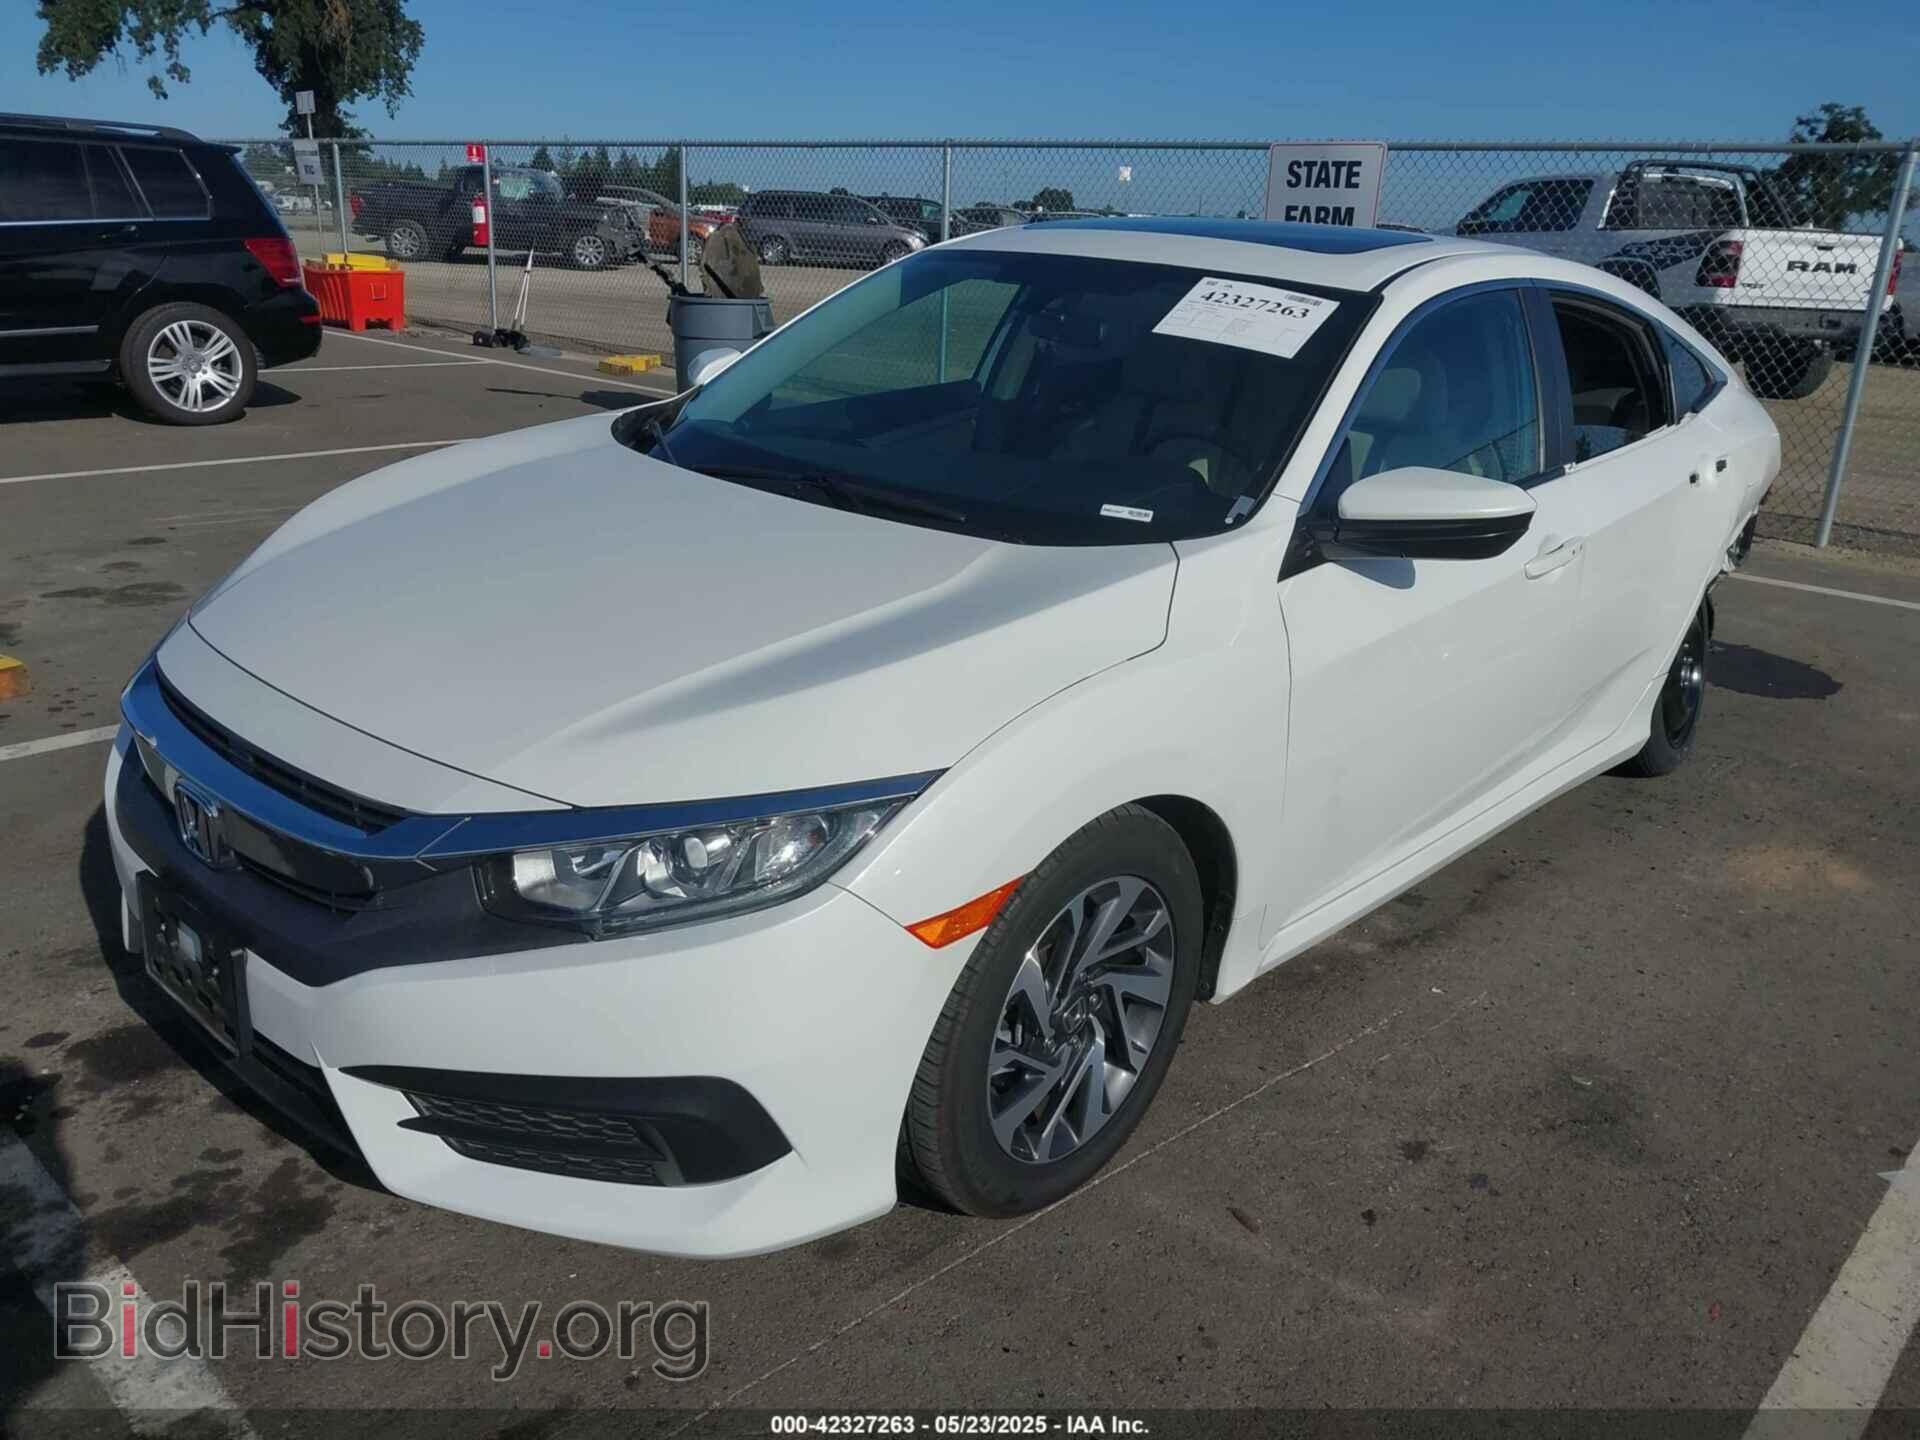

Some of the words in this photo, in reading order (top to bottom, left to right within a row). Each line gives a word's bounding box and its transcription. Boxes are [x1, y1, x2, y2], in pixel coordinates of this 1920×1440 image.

[1286, 160, 1361, 188] STATE
[1787, 261, 1857, 274] RAM
[1201, 291, 1310, 318] 42327263
